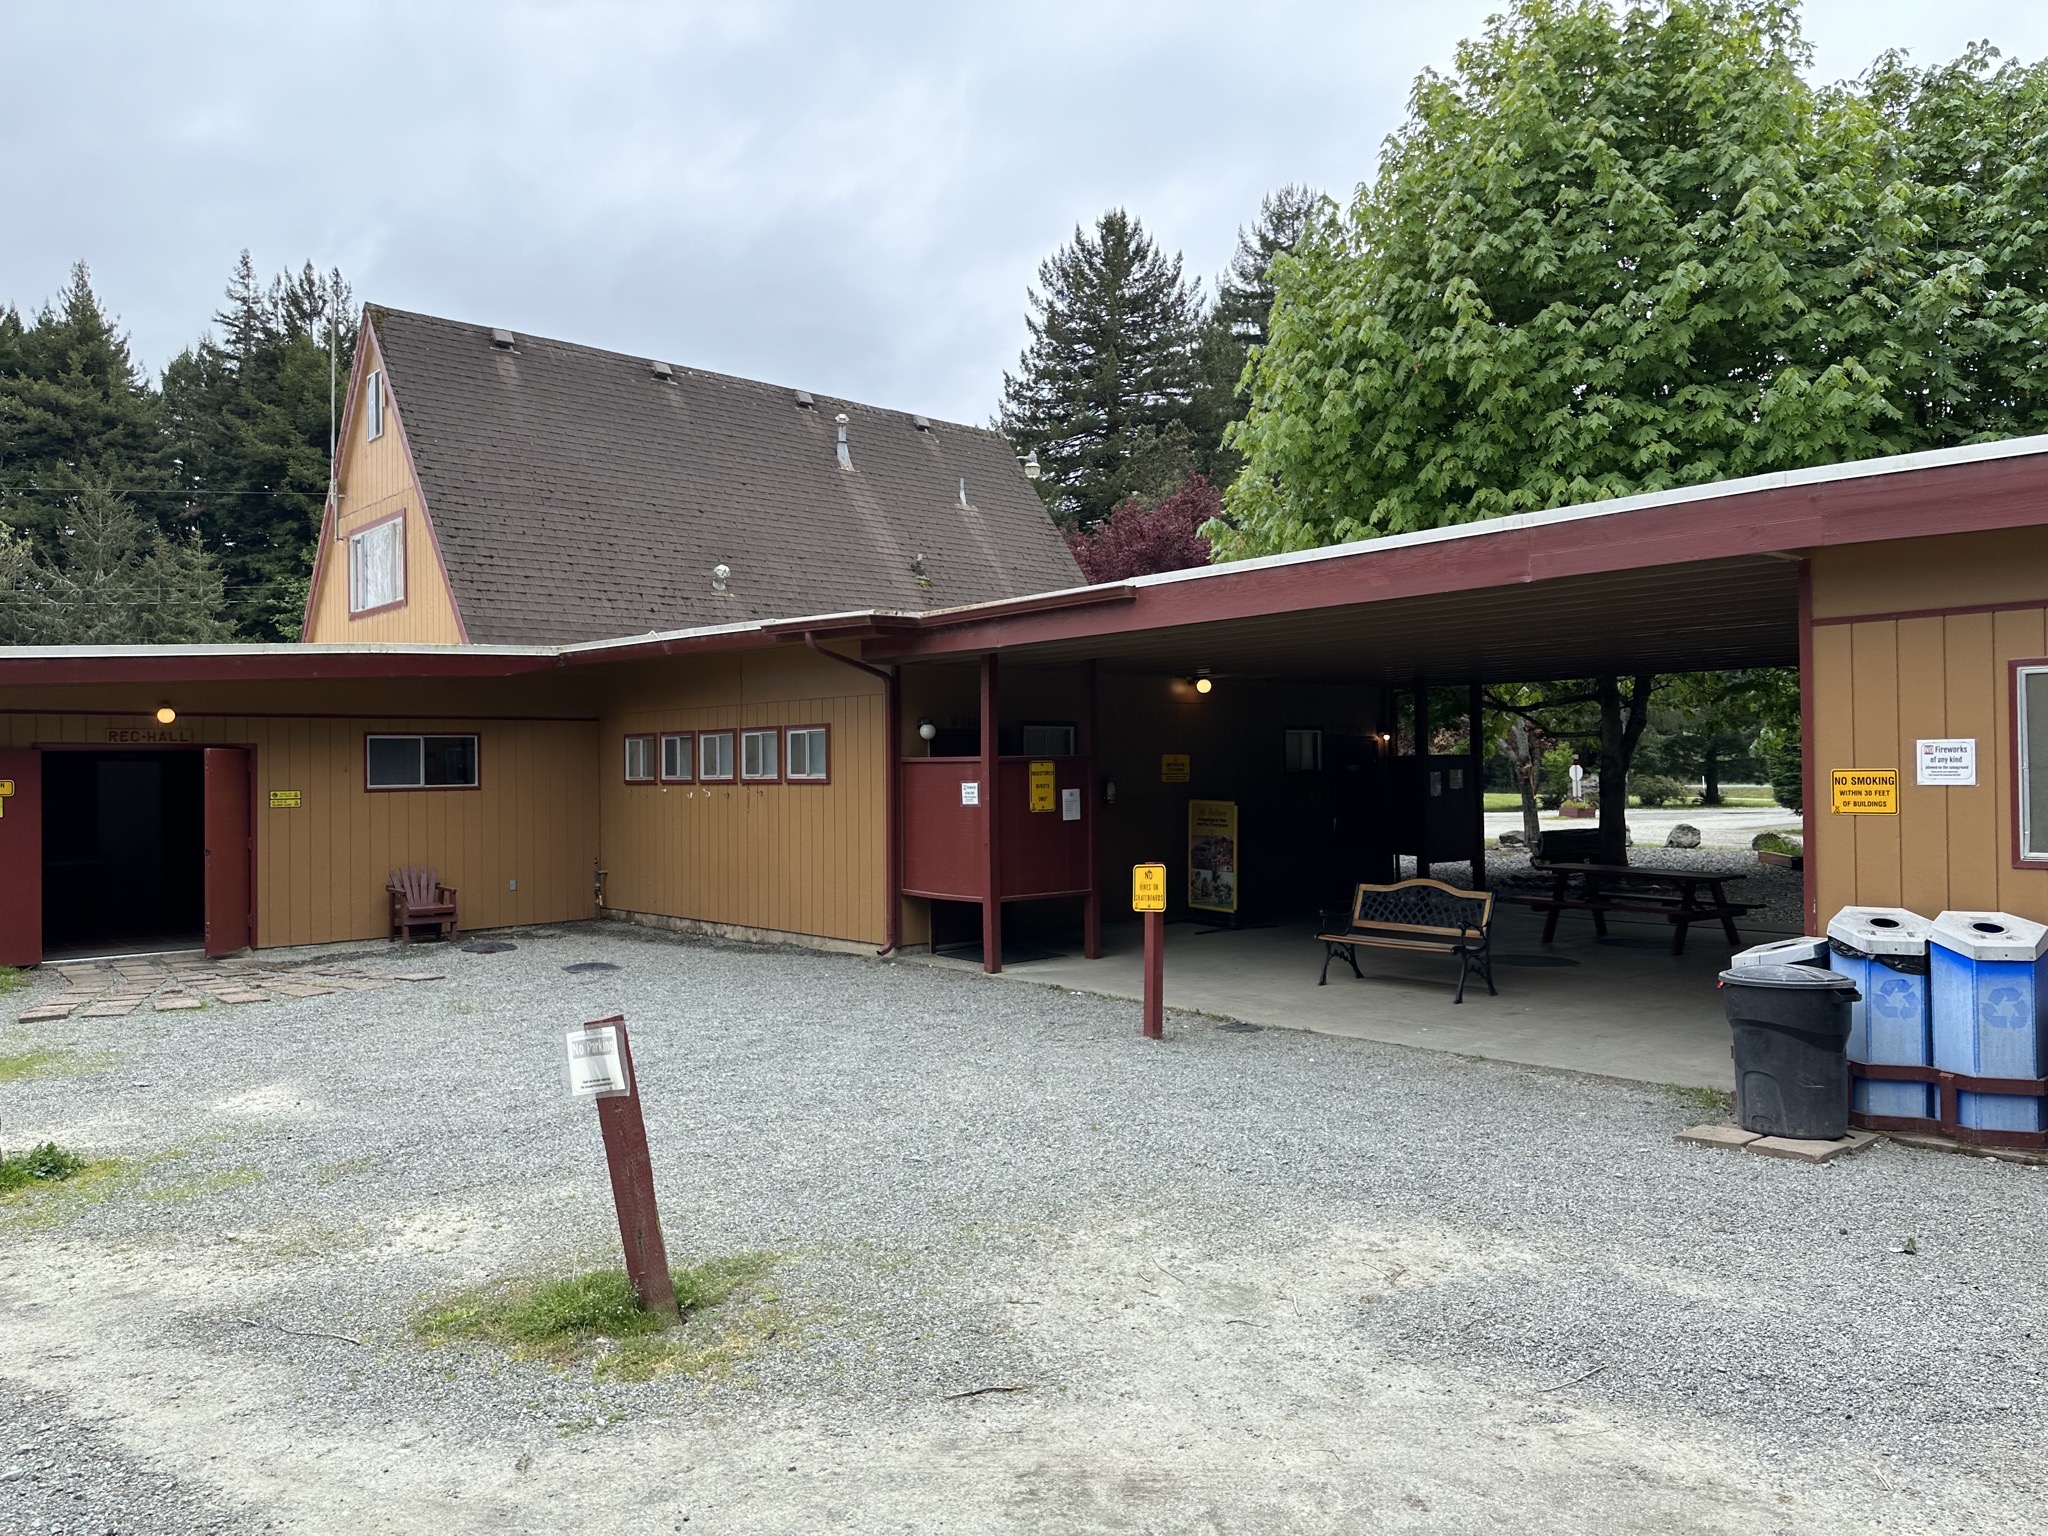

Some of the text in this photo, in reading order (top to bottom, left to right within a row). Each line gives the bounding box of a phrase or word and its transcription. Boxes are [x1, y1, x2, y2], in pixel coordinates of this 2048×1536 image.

[1935, 745, 1968, 754] Fireworks
[1834, 776, 1895, 786] NO SMOKING
[1144, 870, 1153, 880] NO
[1135, 894, 1164, 902] SKATEBOARDS
[572, 1037, 615, 1056] No Parking
